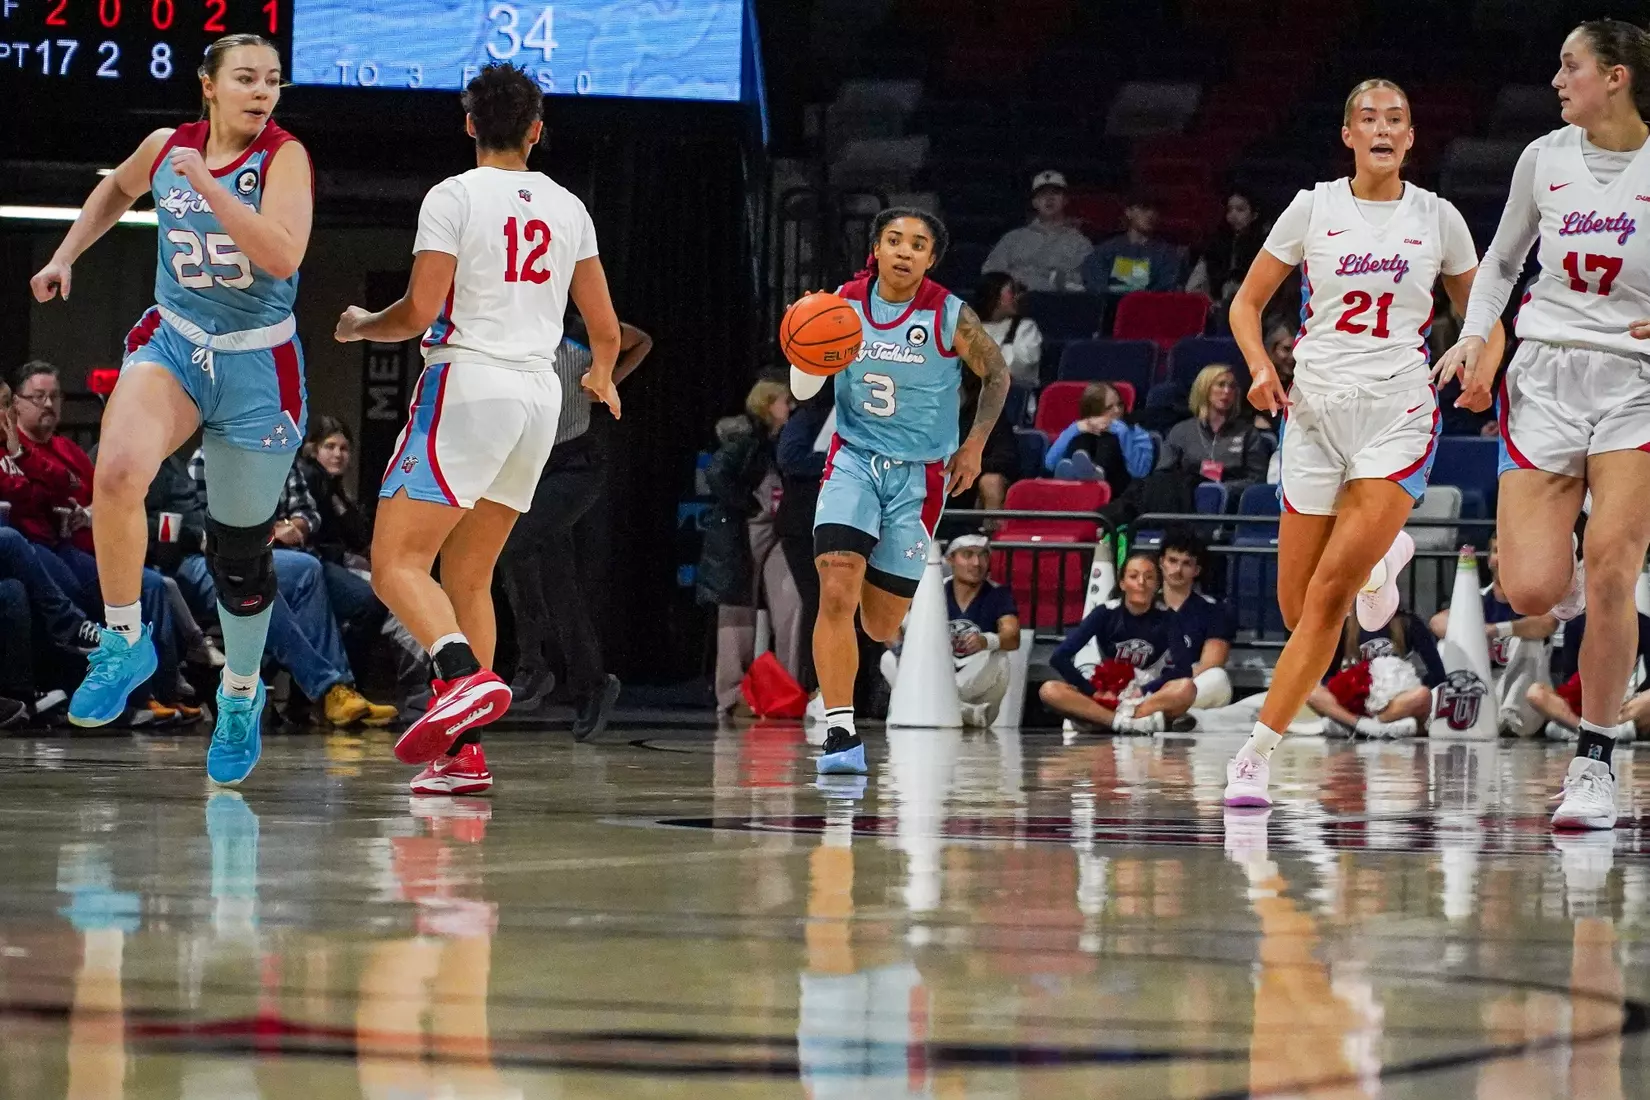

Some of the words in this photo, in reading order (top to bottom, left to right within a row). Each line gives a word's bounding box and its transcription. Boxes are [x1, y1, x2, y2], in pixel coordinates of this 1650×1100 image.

[46, 0, 68, 26] 2
[100, 0, 121, 28] 0
[152, 0, 174, 30] 0
[204, 0, 227, 32] 2
[262, 0, 279, 34] 1
[486, 4, 559, 62] 34
[36, 38, 80, 75] 17
[96, 41, 120, 77] 2
[150, 42, 172, 79] 8
[335, 61, 378, 86] TO
[406, 66, 423, 88] 3
[576, 70, 592, 95] 0
[503, 216, 552, 284] 12
[1559, 210, 1636, 246] Liberty
[167, 229, 255, 289] 25
[1335, 252, 1409, 284] Liberty
[1562, 251, 1624, 296] 17
[1335, 290, 1394, 339] 21
[863, 372, 896, 418] 3
